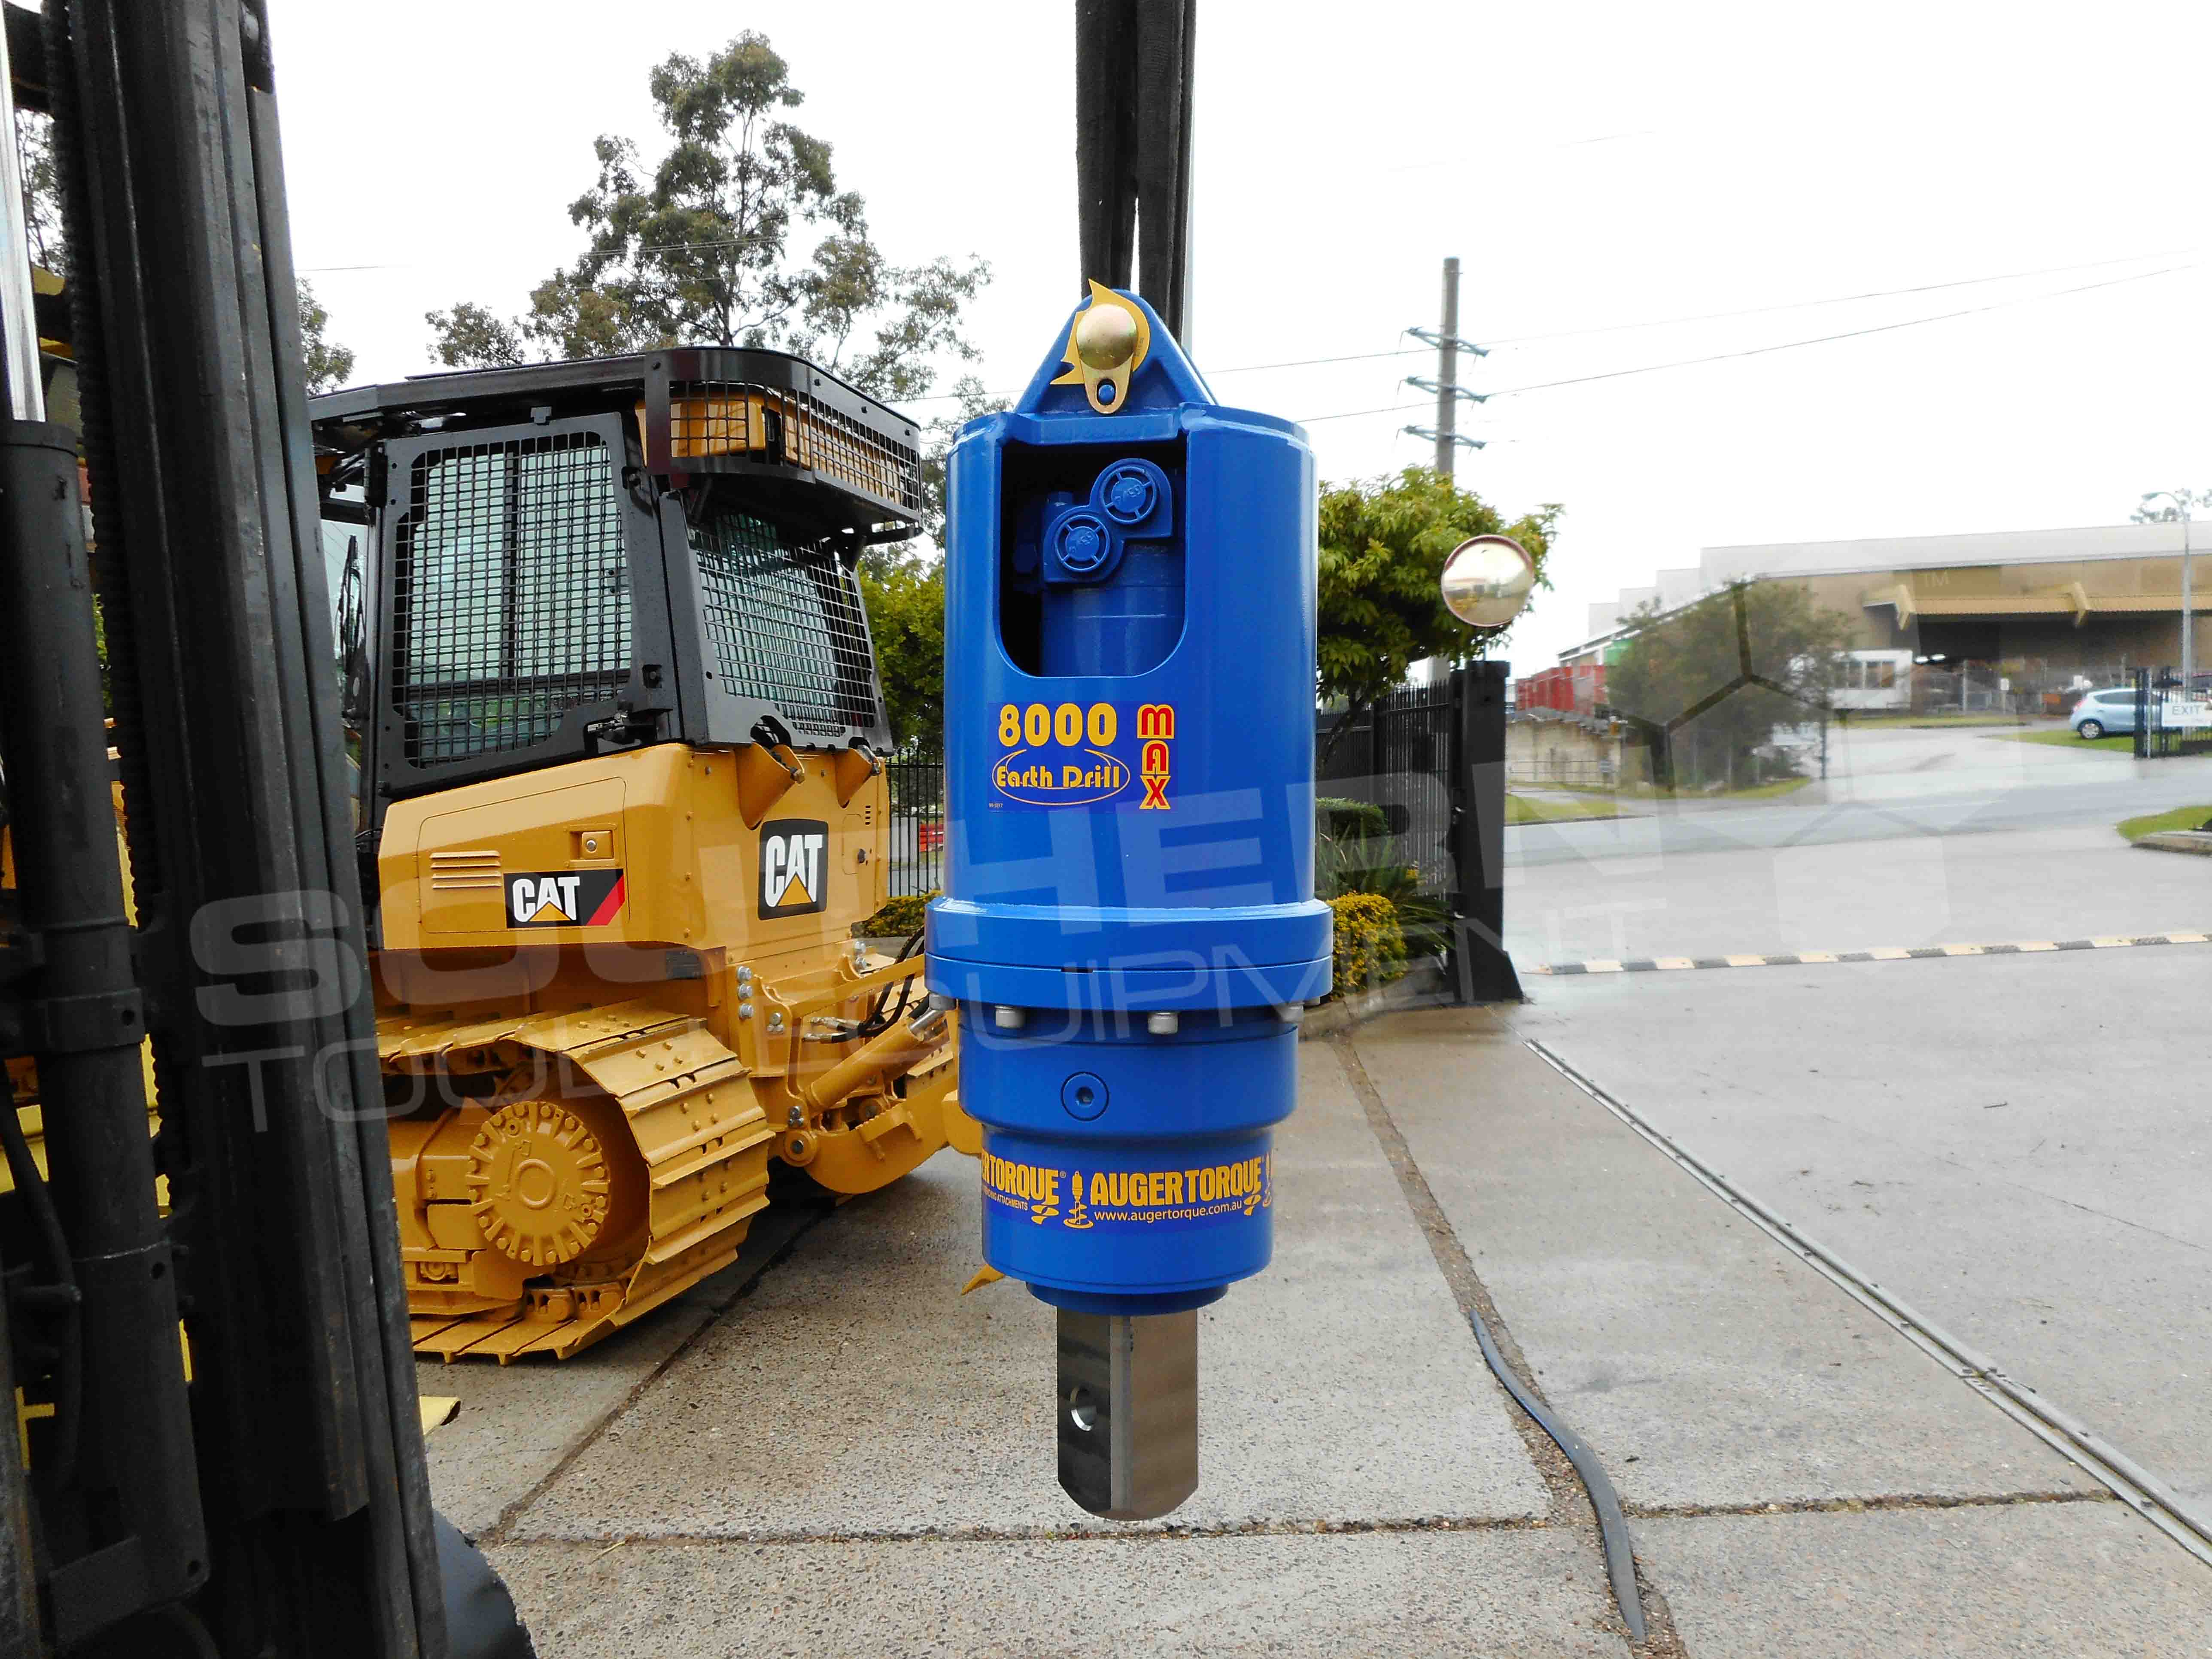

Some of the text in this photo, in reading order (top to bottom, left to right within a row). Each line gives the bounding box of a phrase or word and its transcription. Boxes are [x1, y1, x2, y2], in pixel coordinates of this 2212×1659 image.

[999, 703, 1117, 747] 8000
[2172, 705, 2201, 715] EXIT
[997, 765, 1120, 788] Earth Drill
[765, 834, 823, 907] CAT
[512, 876, 580, 923] CAT
[1094, 1200, 1243, 1224] www.augertorque.com.au
